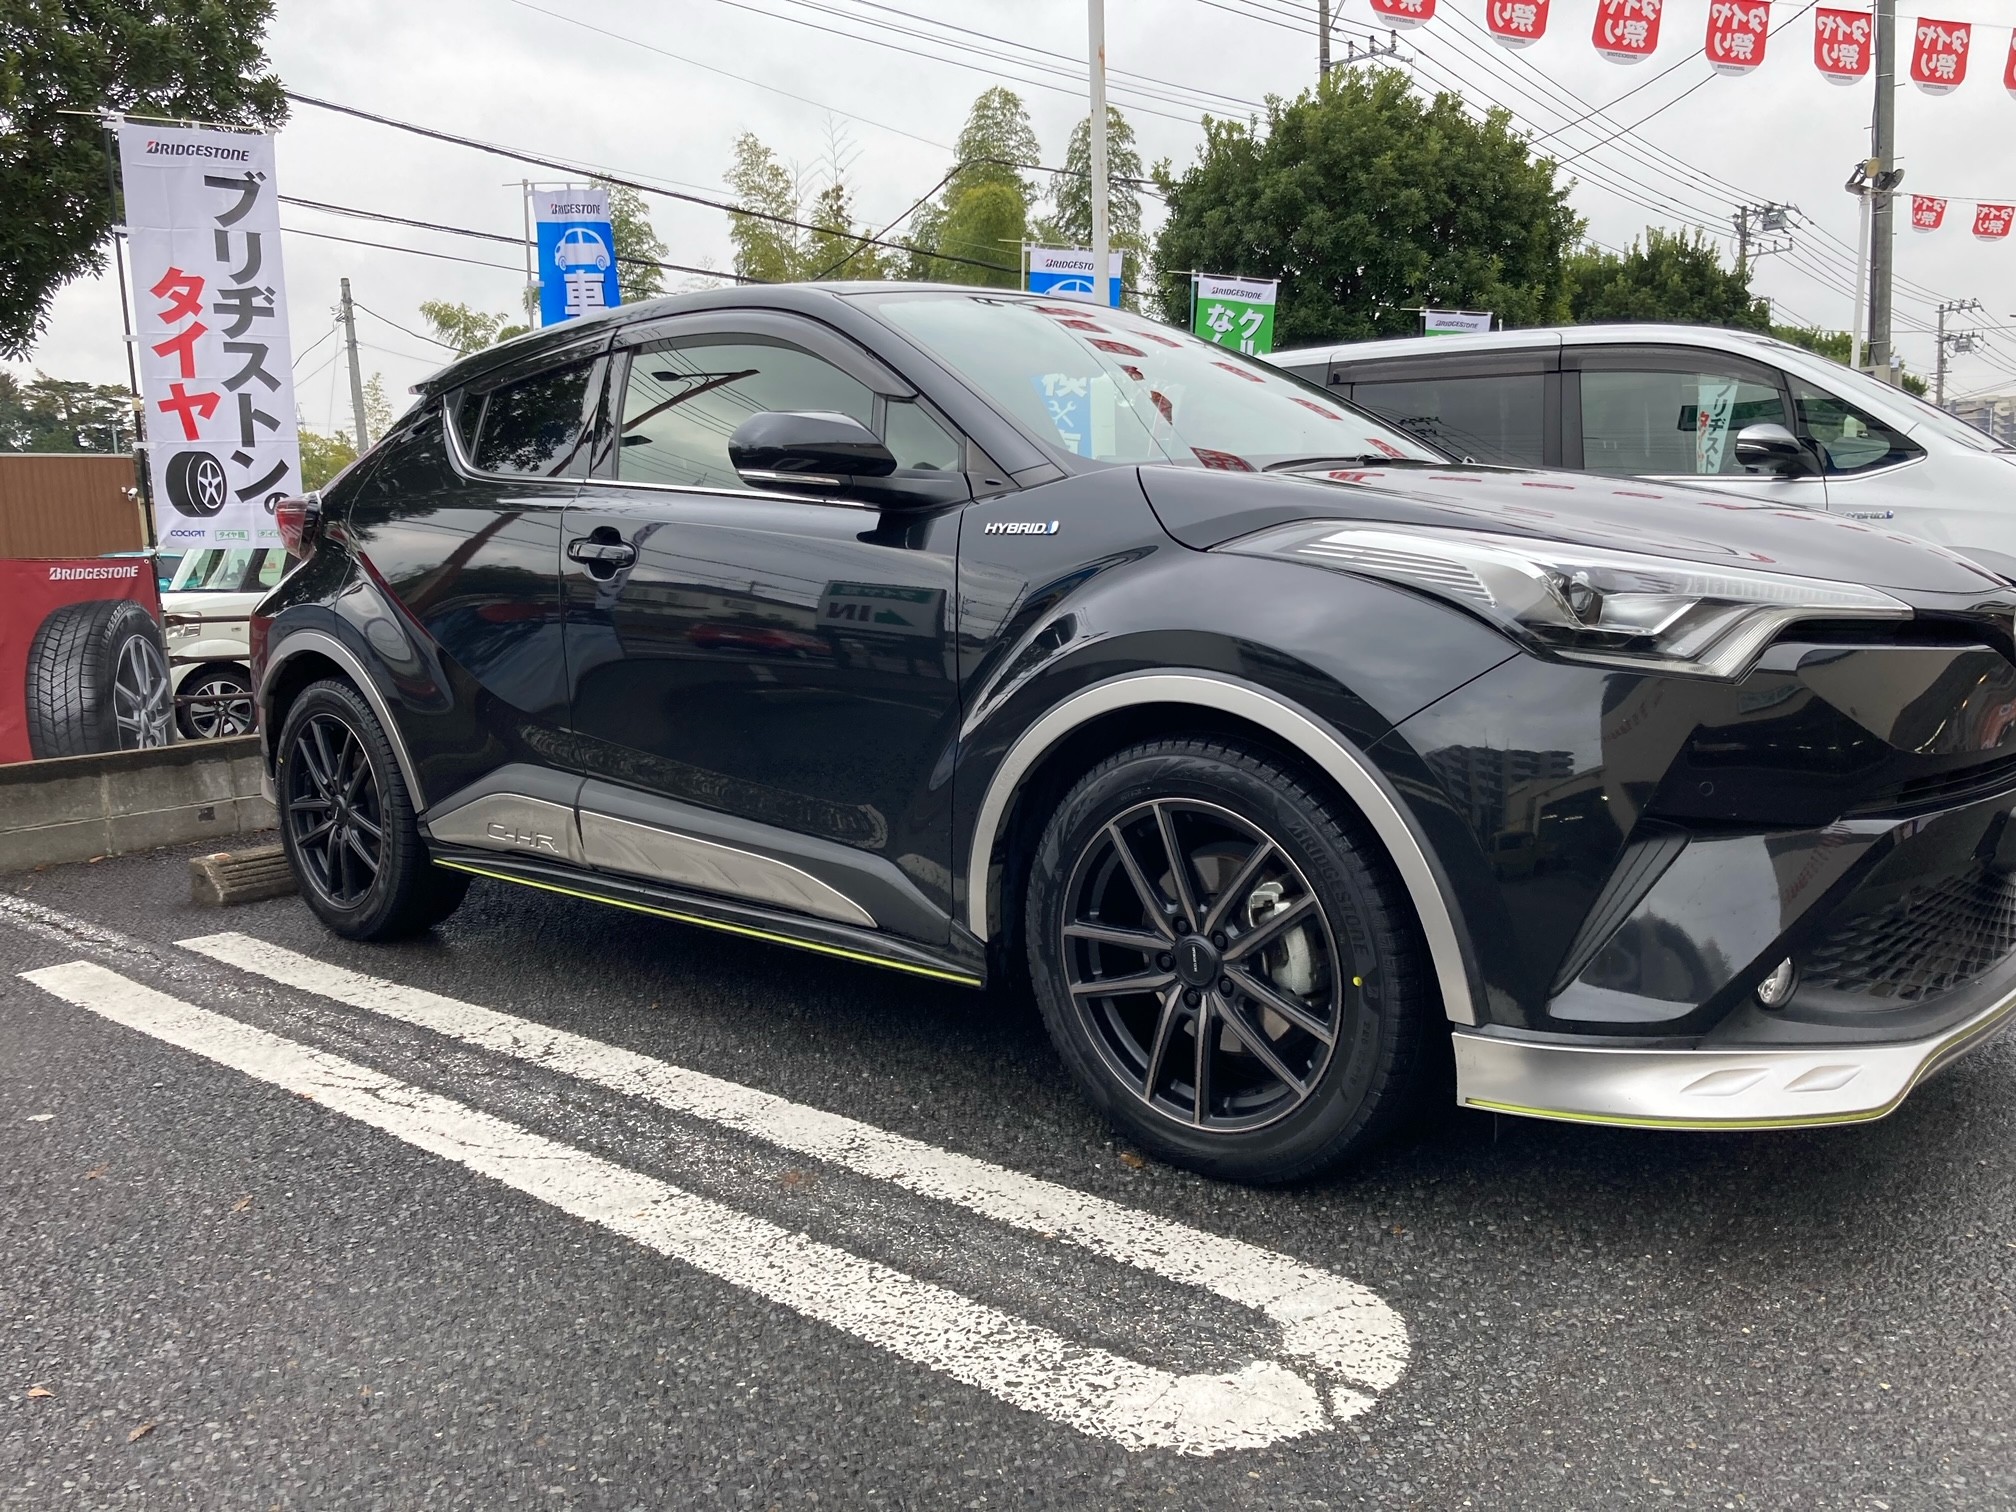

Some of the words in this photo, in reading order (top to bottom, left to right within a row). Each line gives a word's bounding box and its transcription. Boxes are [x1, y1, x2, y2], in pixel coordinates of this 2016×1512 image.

[145, 140, 249, 162] BRIDGESTONE
[550, 203, 601, 215] BRIDGESTONE
[1045, 258, 1094, 271] BRIDGESTO
[564, 269, 609, 317] 車
[1210, 286, 1263, 299] BRIDGESTONE
[1435, 319, 1479, 329] BRIDGESTONE
[150, 266, 221, 442] タイヤ
[170, 529, 206, 537] COCKPIT
[984, 522, 1047, 535] HYBRID
[49, 565, 139, 580] BRIDGESTONE
[487, 822, 559, 853] C-HR
